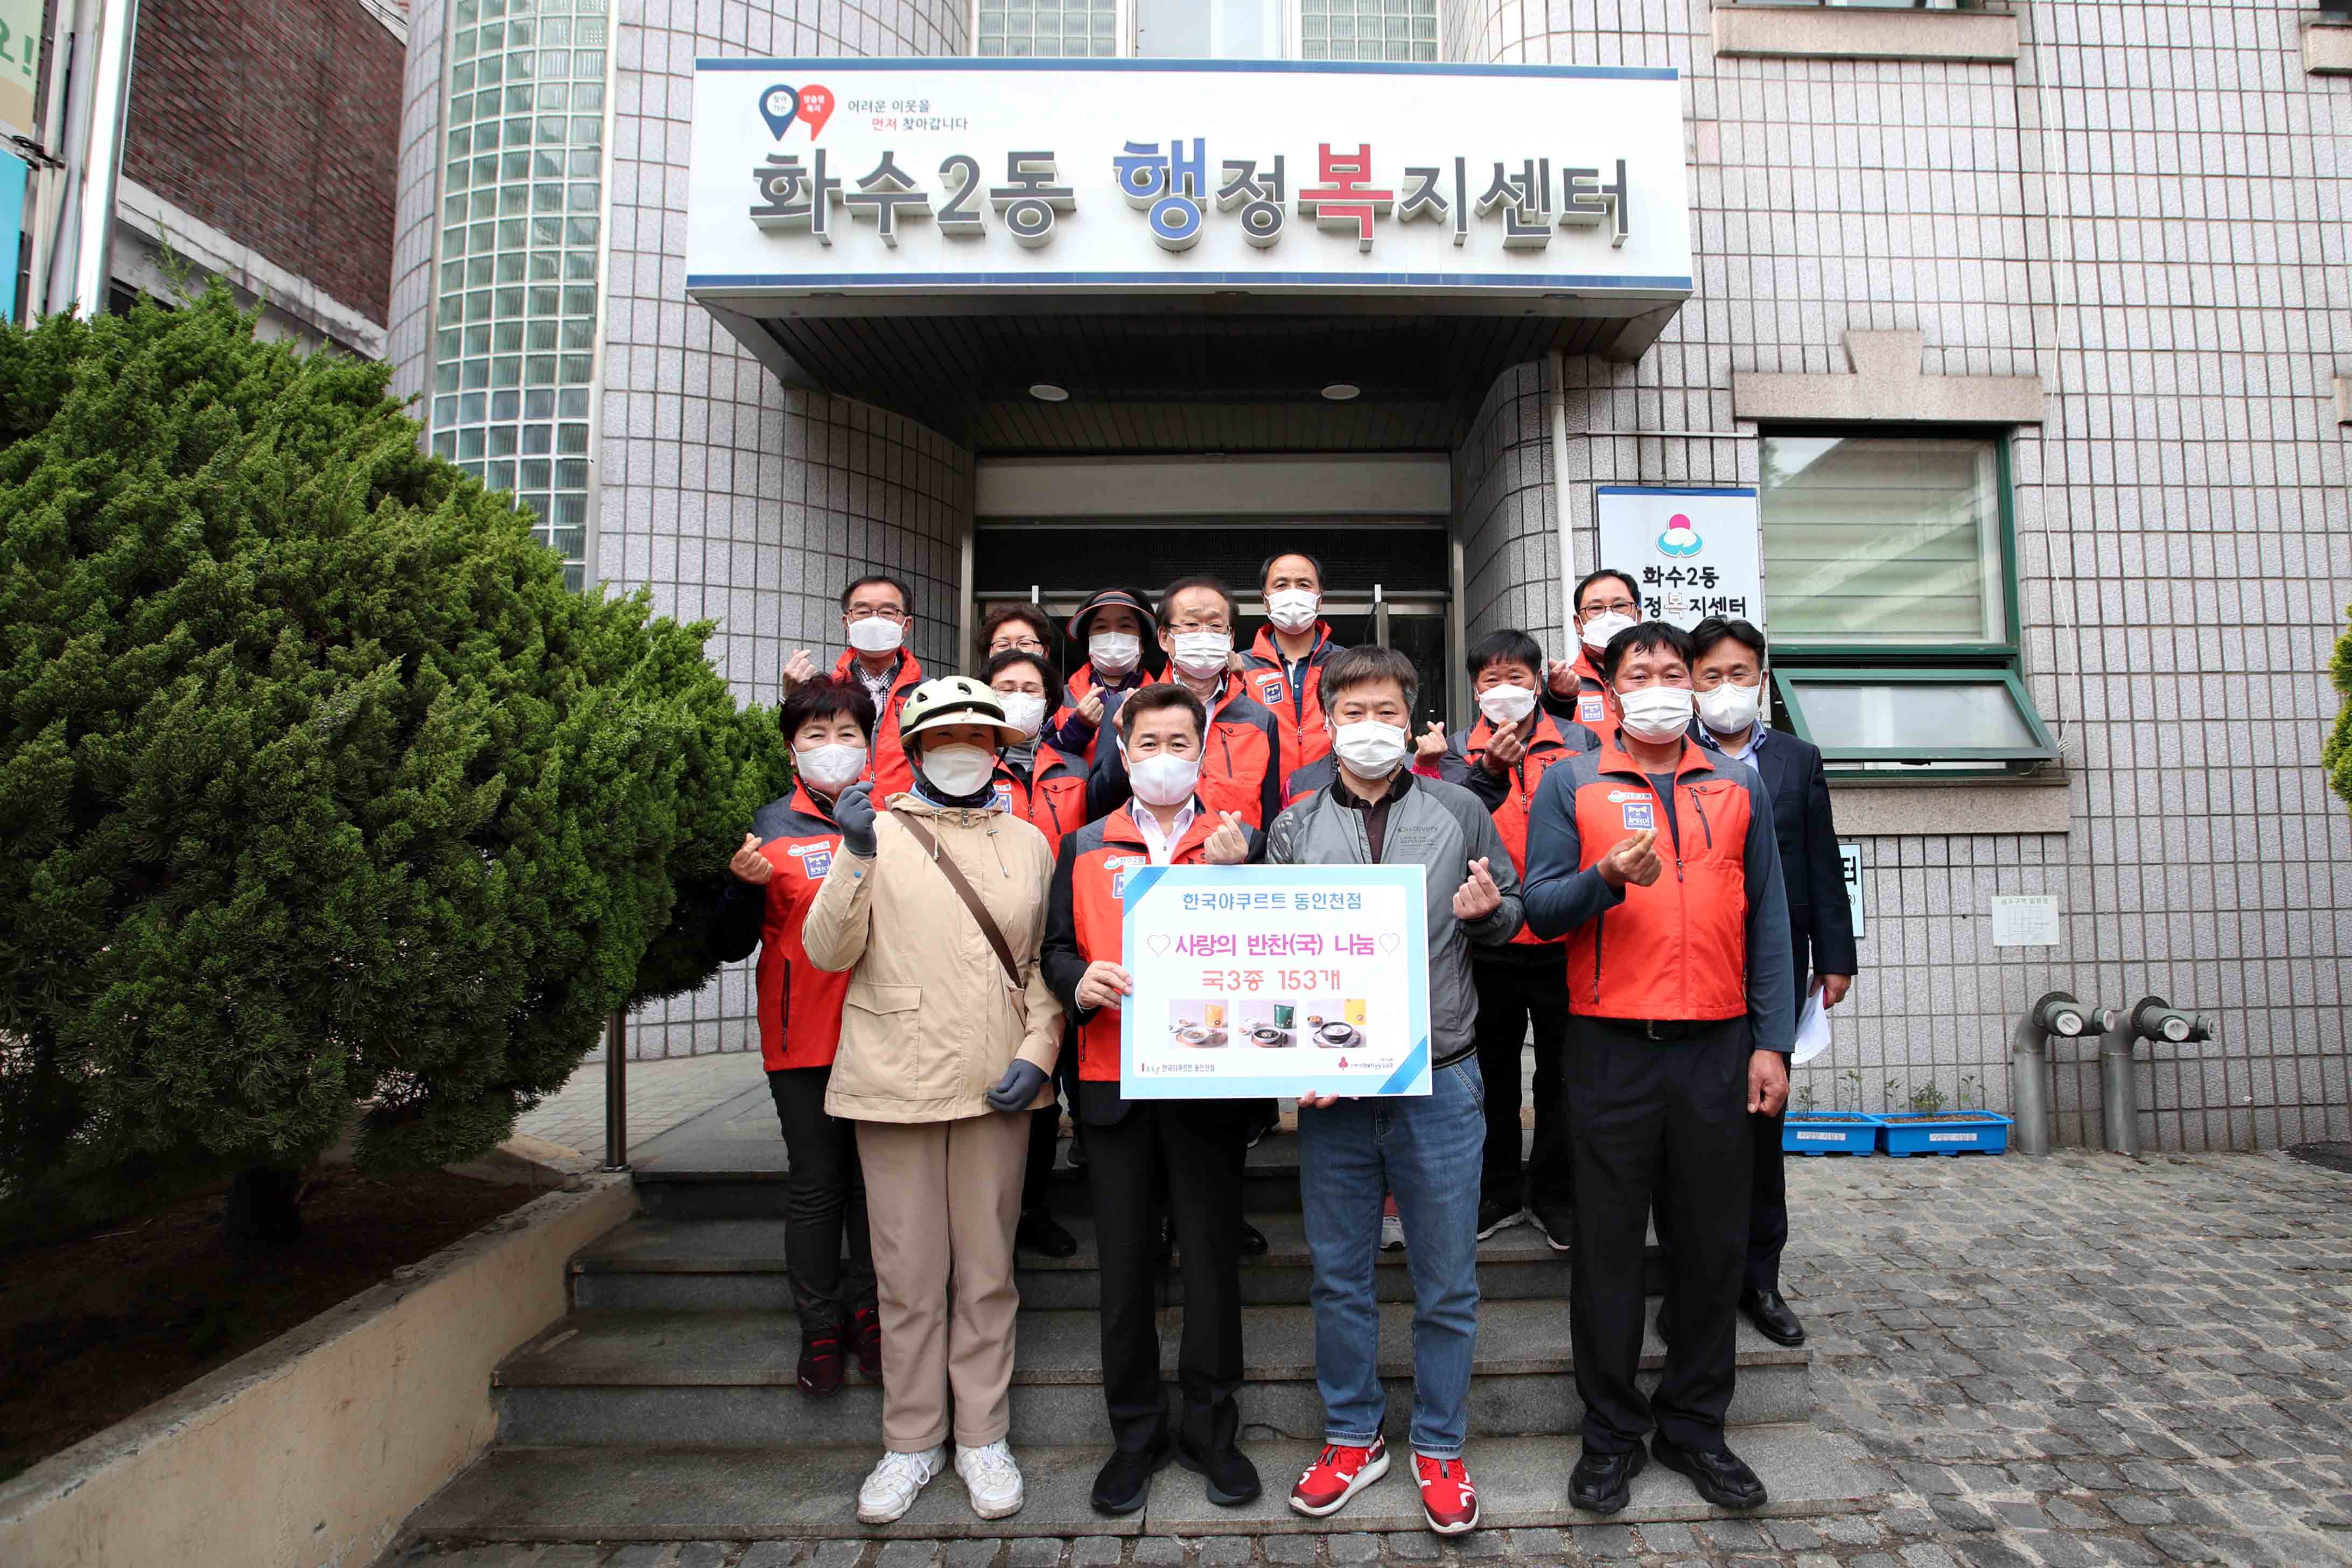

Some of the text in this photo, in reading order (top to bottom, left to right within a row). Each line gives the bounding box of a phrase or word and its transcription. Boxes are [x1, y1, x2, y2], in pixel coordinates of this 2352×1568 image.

[848, 100, 931, 113] 어려운 이웃을
[872, 117, 969, 131] 먼저 찾아갑니다
[750, 137, 1630, 249] 화수2동 행정복지센터
[1643, 565, 1719, 589] 화수2동
[1637, 592, 1746, 619] 정복지센터
[1182, 893, 1362, 910] 한국야쿠르트 동인천점
[1175, 933, 1374, 956] 사랑의 반찬(국) 나눔
[1202, 970, 1340, 991] 국3종 153개
